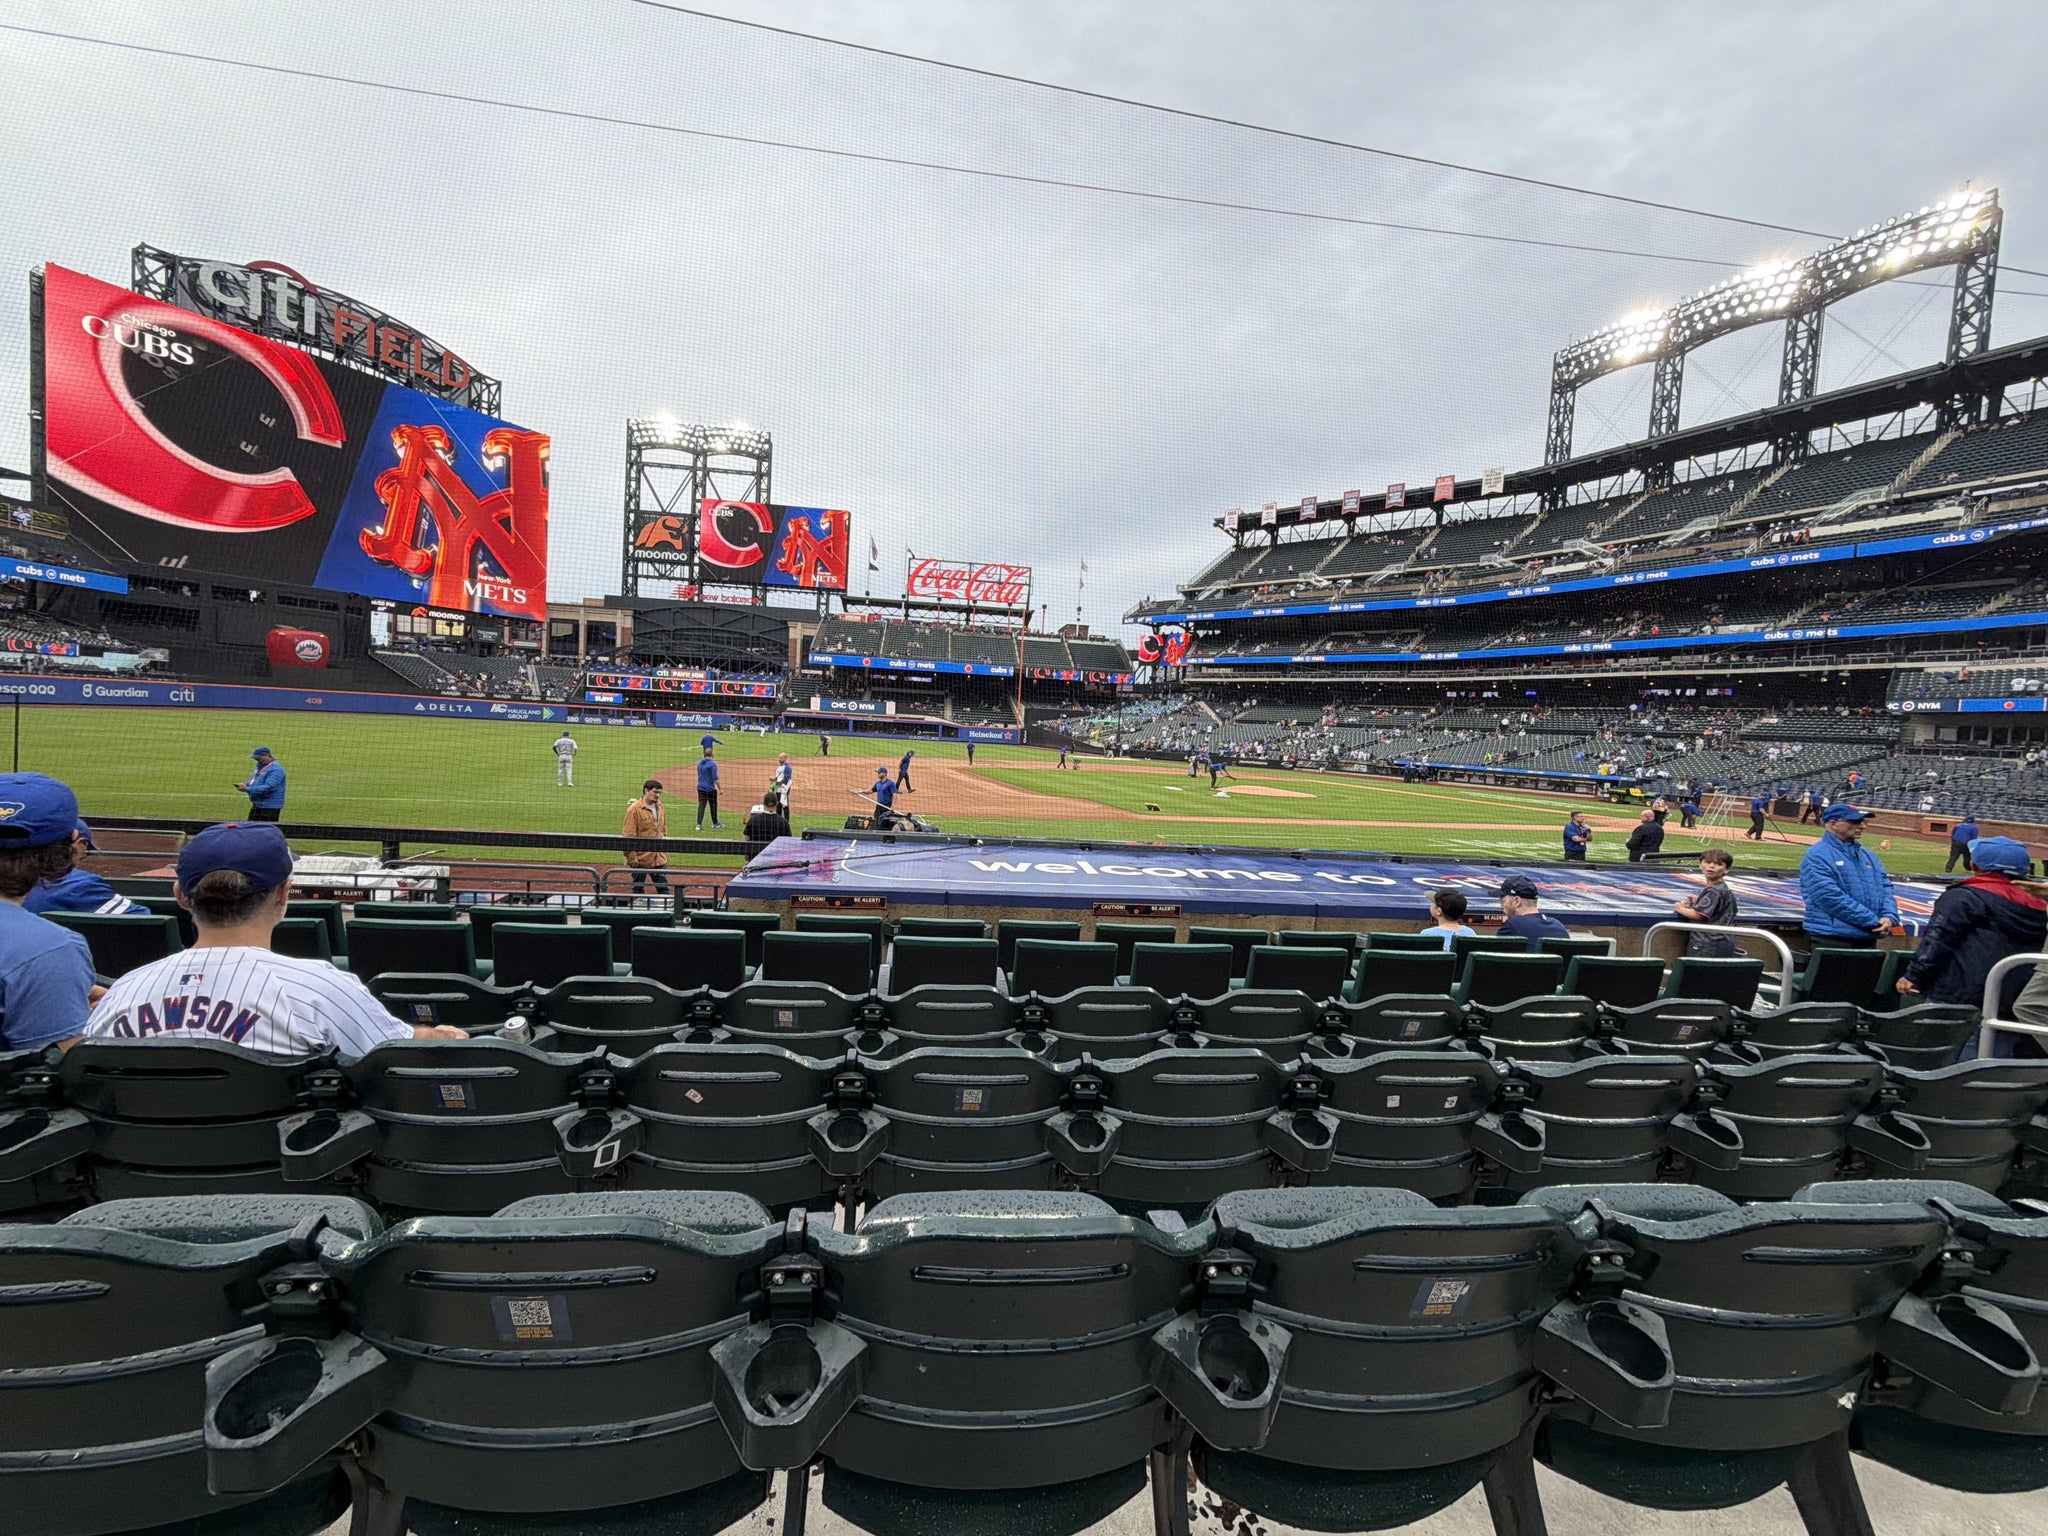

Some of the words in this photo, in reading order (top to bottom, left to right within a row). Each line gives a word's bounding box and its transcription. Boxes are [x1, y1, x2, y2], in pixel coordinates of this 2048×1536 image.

[121, 313, 176, 338] Chicago
[200, 262, 316, 336] citi
[334, 307, 470, 388] FIELD
[82, 315, 194, 365] CUBS
[1998, 523, 2018, 531] cubs
[1933, 533, 1967, 544] cubs
[635, 549, 688, 560] moomoo
[1750, 555, 1775, 566] cubs
[1791, 551, 1820, 562] mets
[16, 565, 43, 577] cubs
[59, 572, 86, 584] mets
[495, 575, 512, 584] York
[812, 574, 838, 583] METS
[1614, 573, 1634, 583] cubs
[1646, 570, 1668, 579] mets
[463, 580, 527, 604] METS
[1507, 587, 1524, 597] cubs
[1532, 585, 1550, 594] mets
[1416, 598, 1431, 606] cubs
[428, 610, 465, 621] moomoo
[1764, 631, 1790, 640] cubs
[1564, 643, 1582, 652] cubs
[1593, 642, 1612, 650] mets
[889, 659, 907, 667] cubs
[990, 666, 1007, 674] cubs
[28, 684, 56, 696] QQQ
[95, 686, 149, 698] Guardian
[170, 688, 195, 702] citi
[428, 702, 473, 713] DELTA
[831, 701, 846, 709] CHC
[859, 702, 875, 711] NYM
[1917, 702, 1941, 710] NYM
[676, 713, 694, 722] Hard
[695, 714, 713, 723] Rock
[969, 730, 1003, 739] Heineken
[967, 859, 1303, 883] welcome
[1313, 871, 1397, 886] to
[113, 995, 262, 1045] DAWSON
